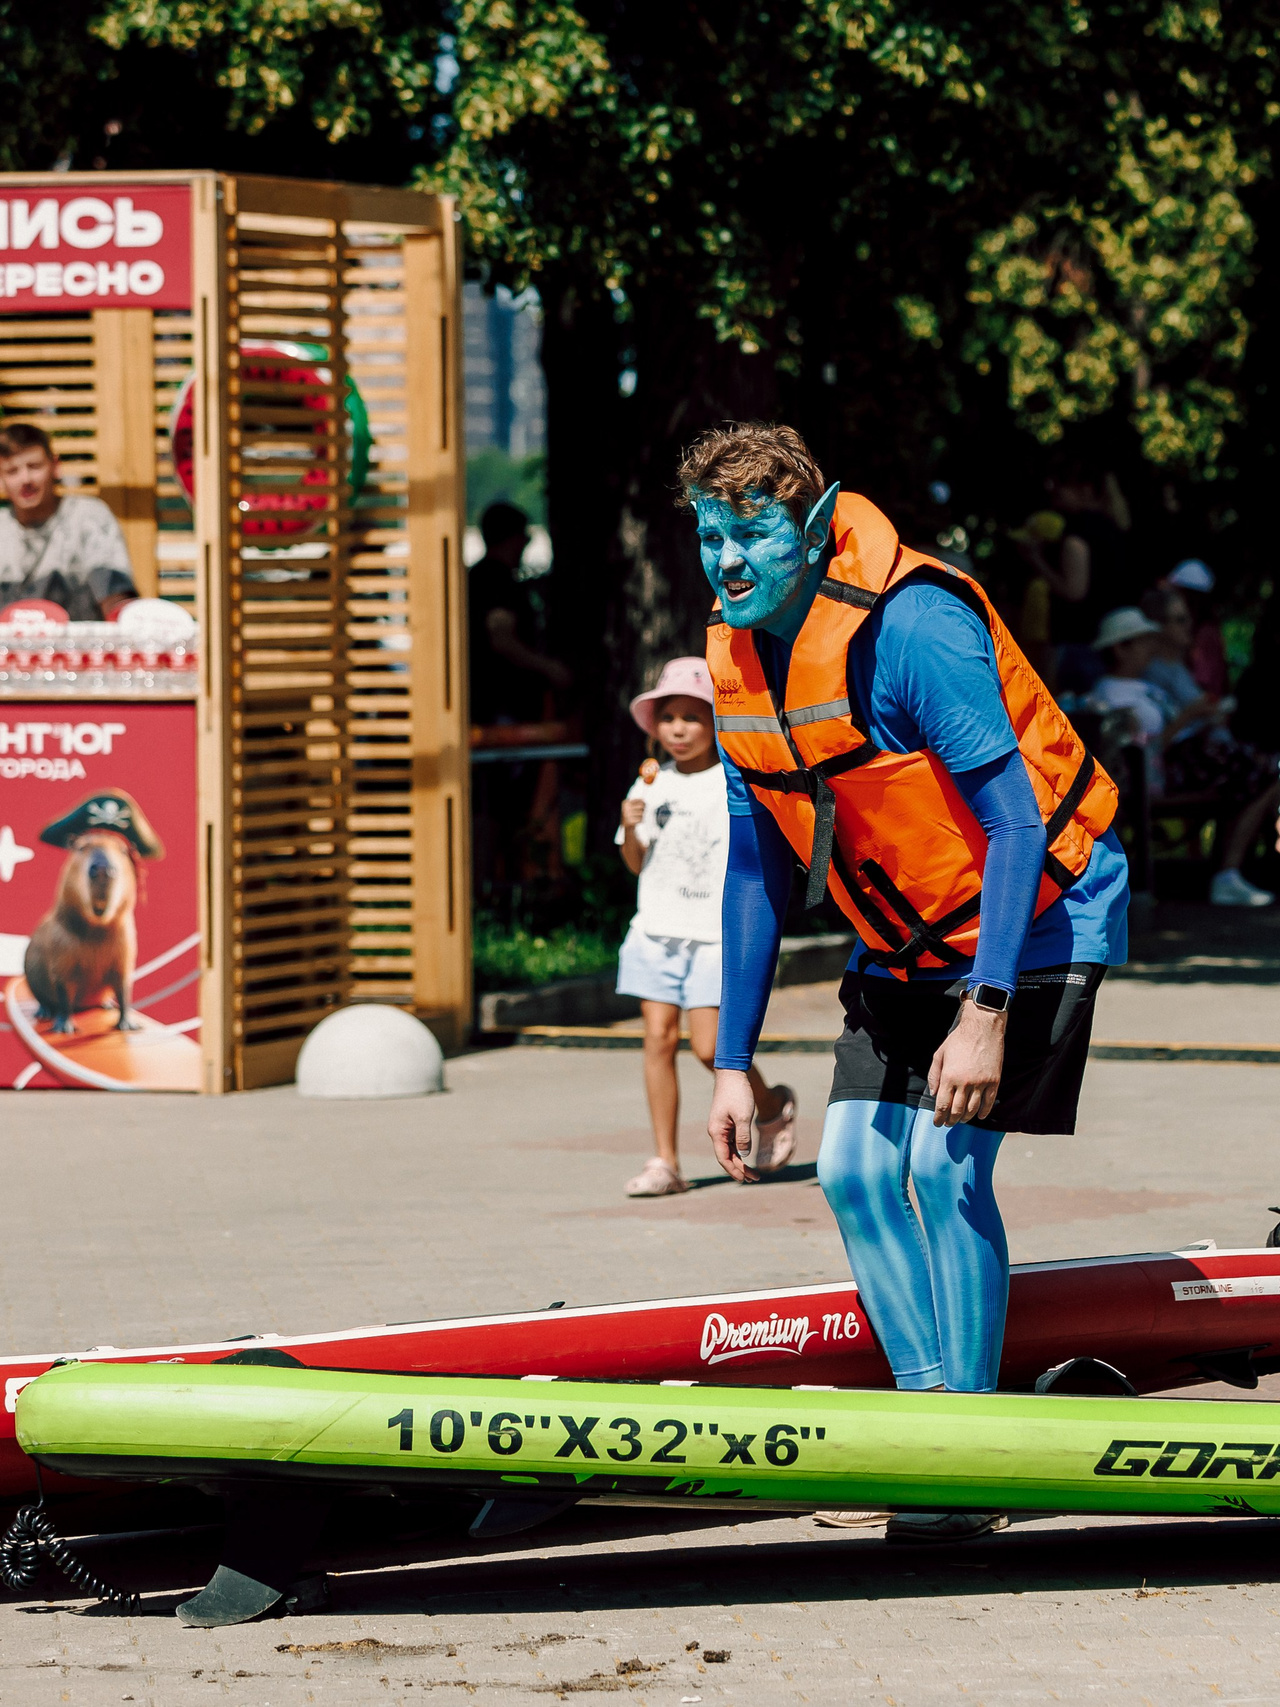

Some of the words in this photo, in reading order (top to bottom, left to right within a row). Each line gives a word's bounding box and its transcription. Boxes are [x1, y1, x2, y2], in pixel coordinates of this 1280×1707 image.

[0, 197, 164, 249] ИСЬ
[0, 259, 165, 297] РЕСНО
[0, 757, 87, 781] ОРОДА
[1182, 1283, 1233, 1296] STORMLINE
[700, 1312, 820, 1363] Premium
[822, 1312, 860, 1341] 11.6
